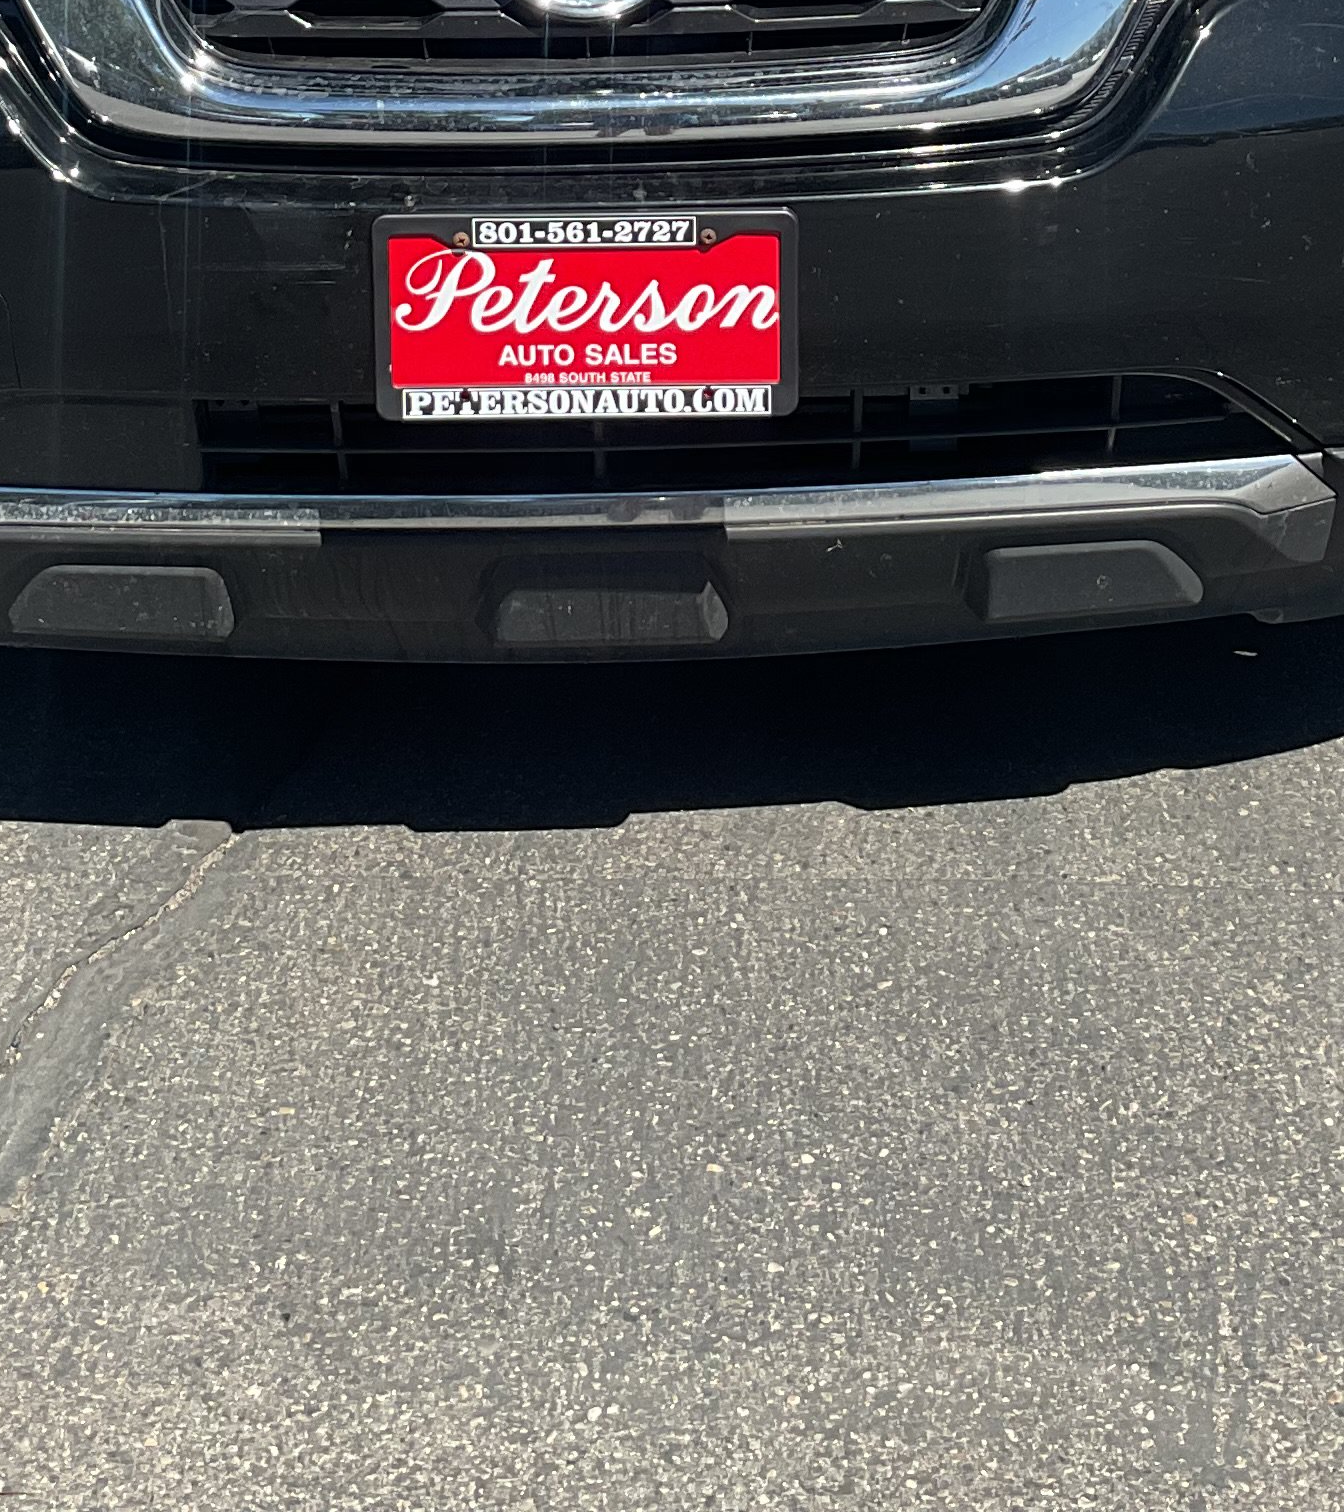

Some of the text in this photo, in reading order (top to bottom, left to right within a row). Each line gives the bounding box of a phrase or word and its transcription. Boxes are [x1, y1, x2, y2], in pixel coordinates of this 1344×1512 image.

[478, 220, 690, 244] 801-561-2727
[395, 248, 780, 334] Peterson
[498, 342, 677, 367] AUTO SALES
[559, 371, 606, 384] SOUTH
[610, 371, 652, 383] STATE
[408, 387, 767, 416] PETERSONAUTO.COM
